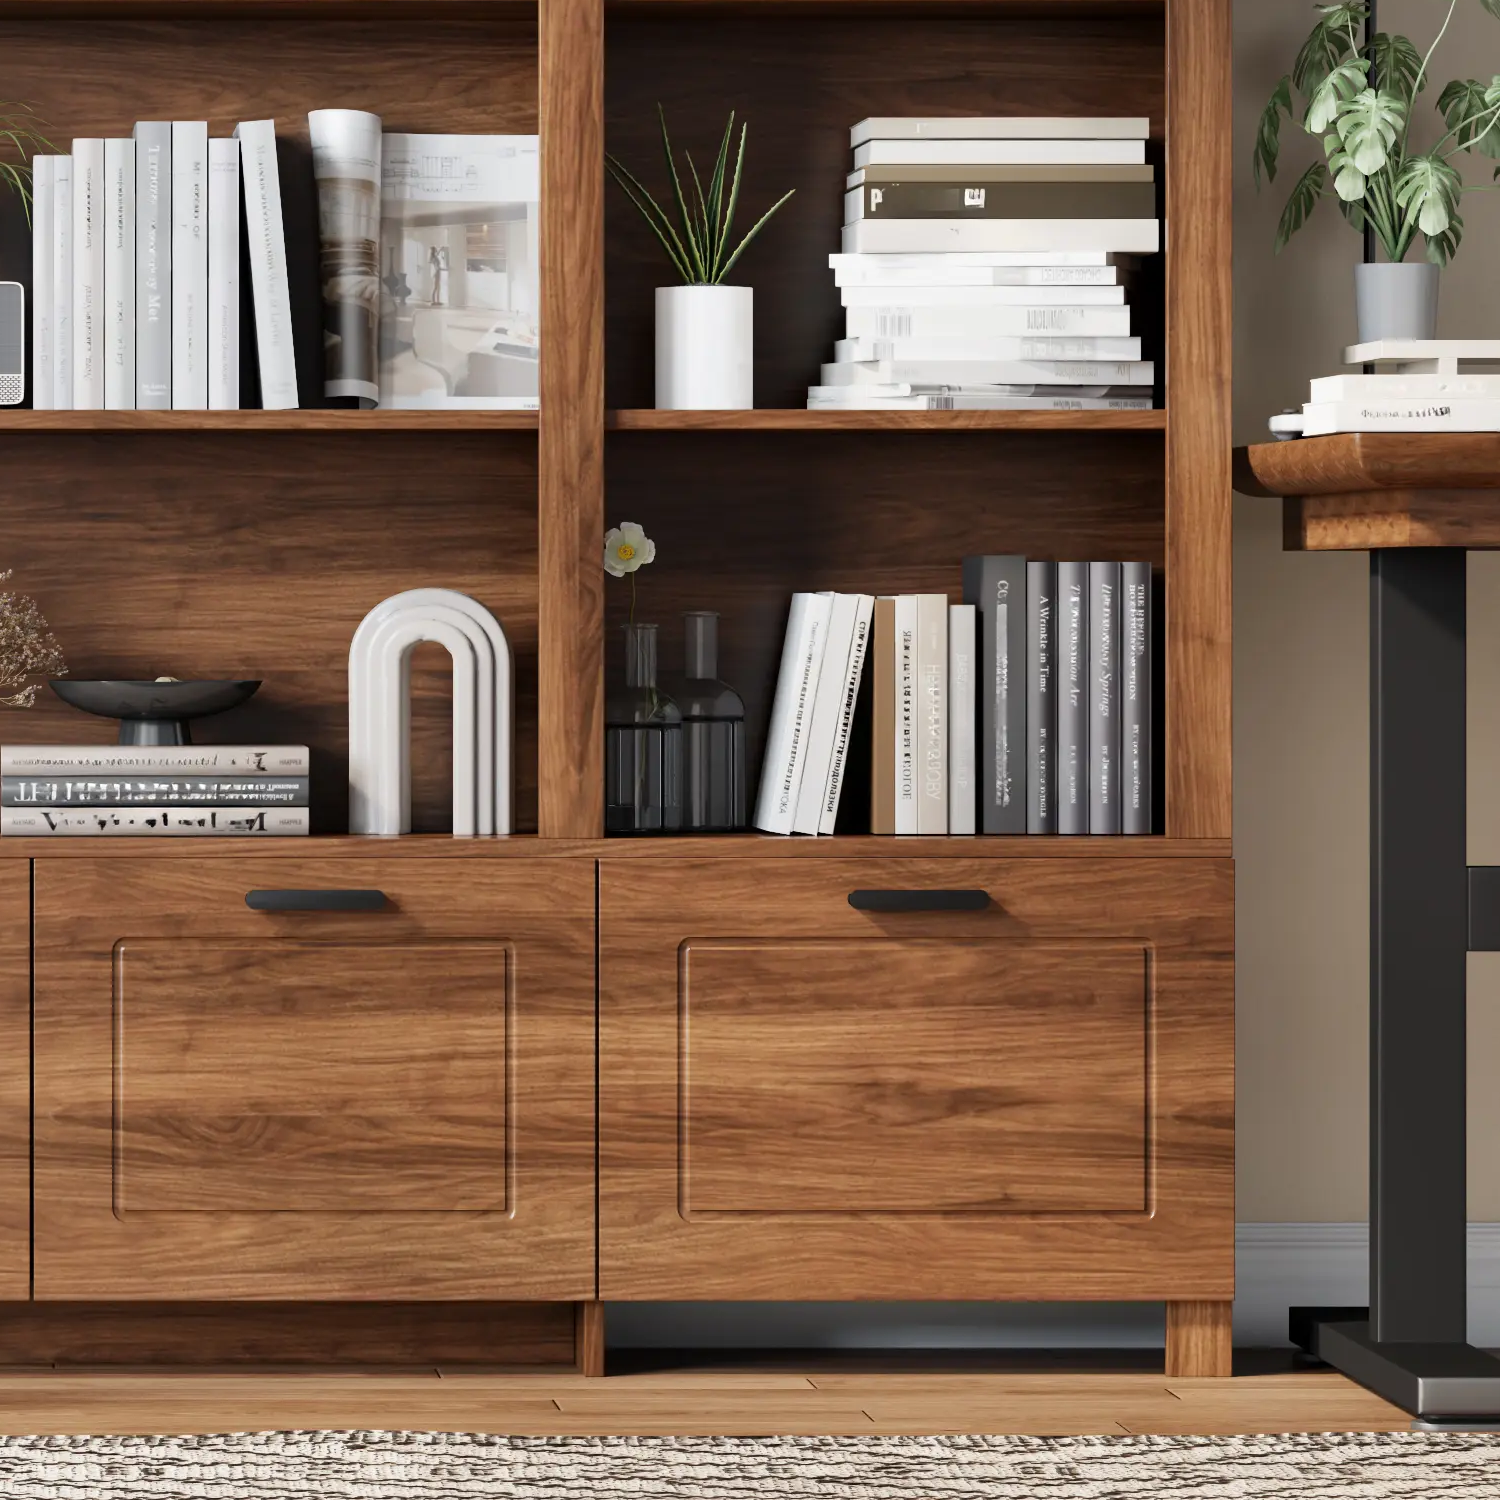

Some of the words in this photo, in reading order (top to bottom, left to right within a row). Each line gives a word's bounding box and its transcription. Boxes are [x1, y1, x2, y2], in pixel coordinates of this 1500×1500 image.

[1038, 606, 1049, 650] Wrinkle
[1038, 665, 1049, 693] Time
[1069, 683, 1081, 707] Are
[1098, 670, 1113, 718] Springs
